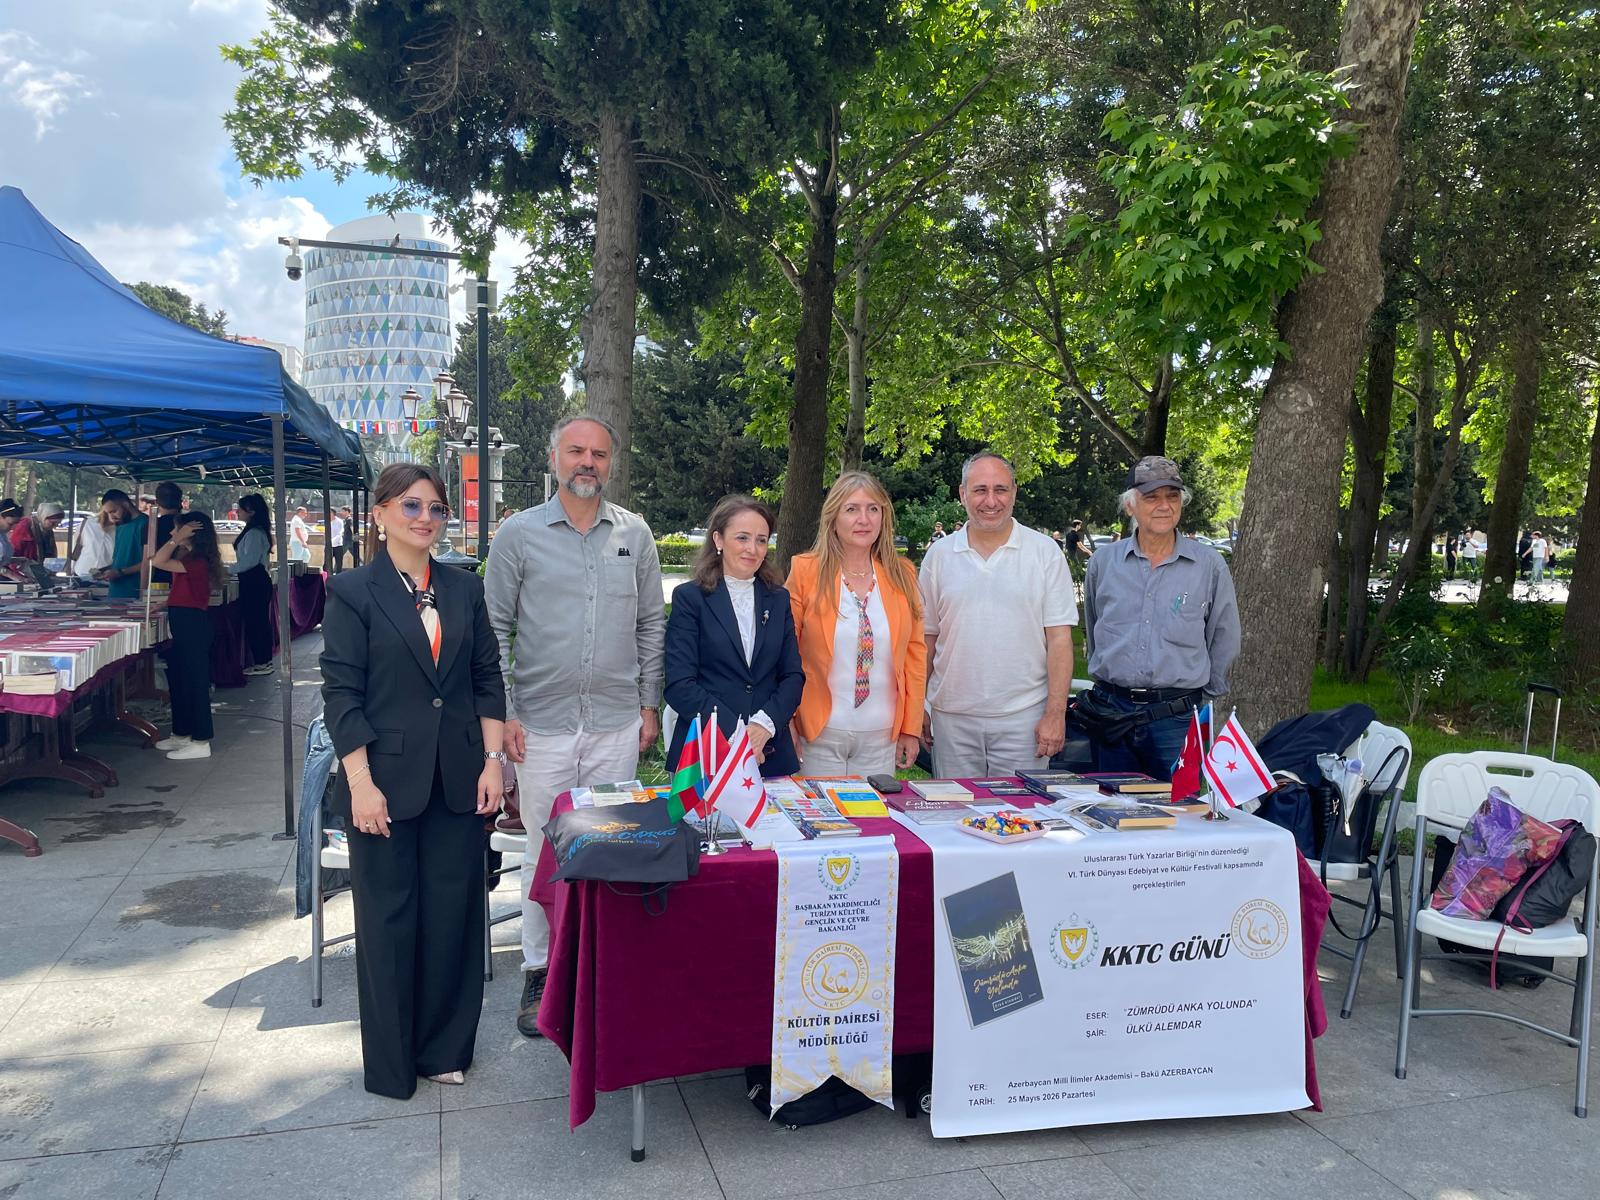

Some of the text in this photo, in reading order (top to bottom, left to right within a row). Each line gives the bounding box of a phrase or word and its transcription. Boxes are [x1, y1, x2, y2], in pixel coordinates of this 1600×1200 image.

[1084, 854, 1127, 863] Uluslararası
[1128, 853, 1145, 861] Türk
[1146, 851, 1175, 860] Yazarlar
[1079, 869, 1096, 878] Türk
[1097, 868, 1127, 878] Dünyası
[1128, 866, 1159, 877] Edebiyat
[1170, 864, 1192, 873] Kültür
[1193, 862, 1222, 871] Festivali
[1223, 860, 1264, 871] kapsamında
[1132, 880, 1186, 890] gerçekleştirilen
[795, 898, 880, 911] BAŞBAKAN YARDIMCILIĞI
[810, 908, 865, 917] TURİZM KÜLTÜR
[804, 918, 836, 926] GENÇLİK
[847, 915, 870, 924] ÇEVRE
[818, 924, 856, 933] BAKANLIĞI
[1100, 933, 1231, 967] KKTC GÜNÜ
[1086, 1012, 1109, 1020] ESER:
[1177, 1002, 1203, 1013] ANKA
[788, 1010, 880, 1028] KÜLTÜR DAİRESİ
[1126, 1022, 1152, 1034] ÜLKÜ
[1154, 1020, 1202, 1032] ALEMDAR
[798, 1031, 868, 1048] MÜDÜRLÜĞÜ
[968, 1083, 988, 1092] YER:
[1008, 1079, 1051, 1089] Azerbaycan
[1070, 1074, 1093, 1083] İlimler
[1095, 1072, 1133, 1082] Akademisi
[1140, 1070, 1160, 1078] Bakü
[1161, 1067, 1213, 1077] AZERBAYCAN
[969, 1097, 995, 1107] TARİH:
[1019, 1094, 1041, 1103] Mayıs
[1042, 1092, 1060, 1101] 2026
[1061, 1090, 1096, 1100] Pazartesi
